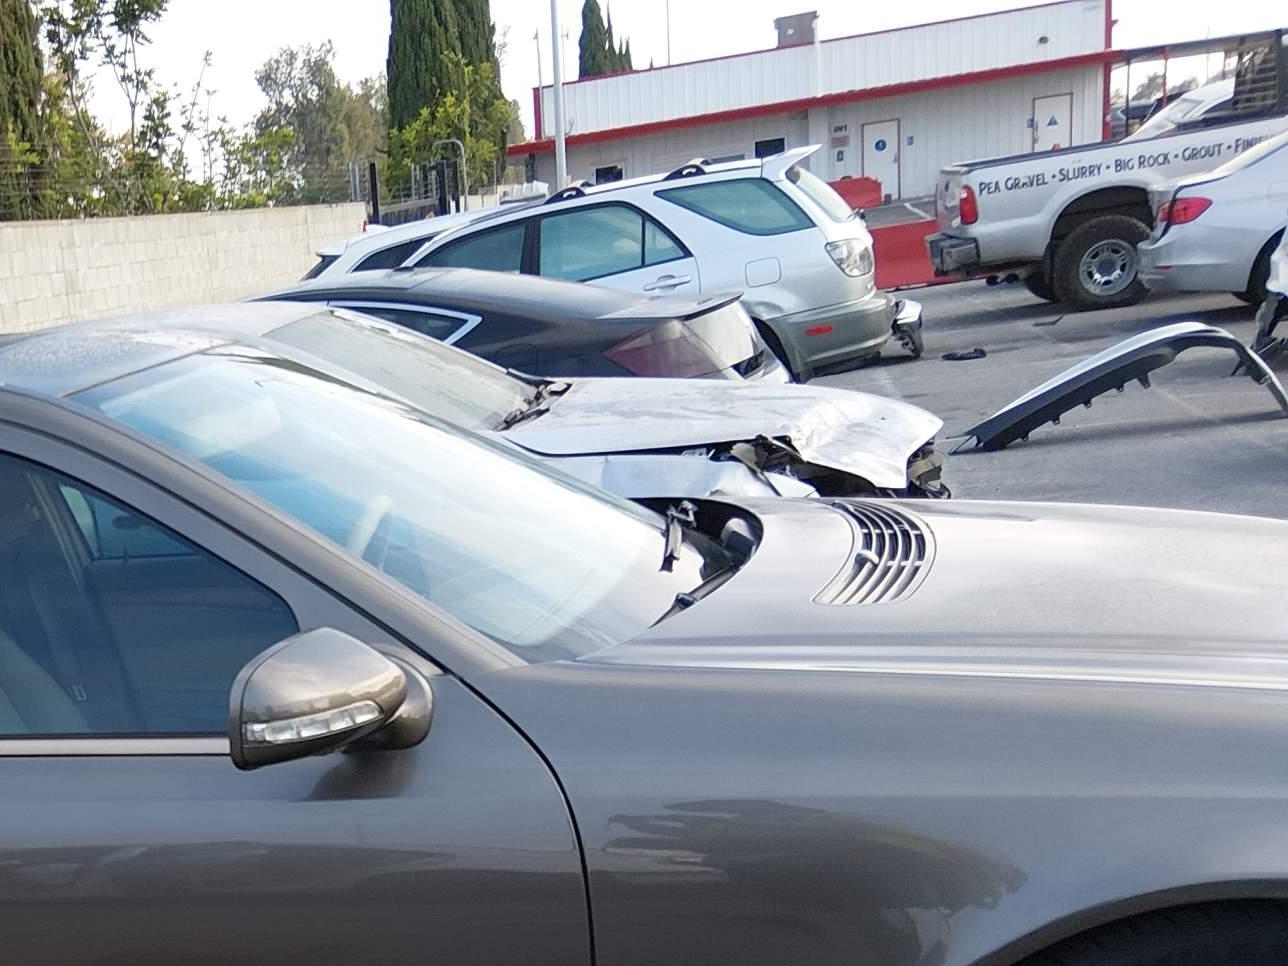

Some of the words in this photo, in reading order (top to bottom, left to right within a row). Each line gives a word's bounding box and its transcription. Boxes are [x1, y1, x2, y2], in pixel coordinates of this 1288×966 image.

[978, 181, 1001, 196] PEA
[1059, 163, 1102, 182] SLURRY
[1114, 159, 1134, 172] BIG
[1138, 152, 1170, 169] ROCK
[1182, 143, 1224, 161] GROUT
